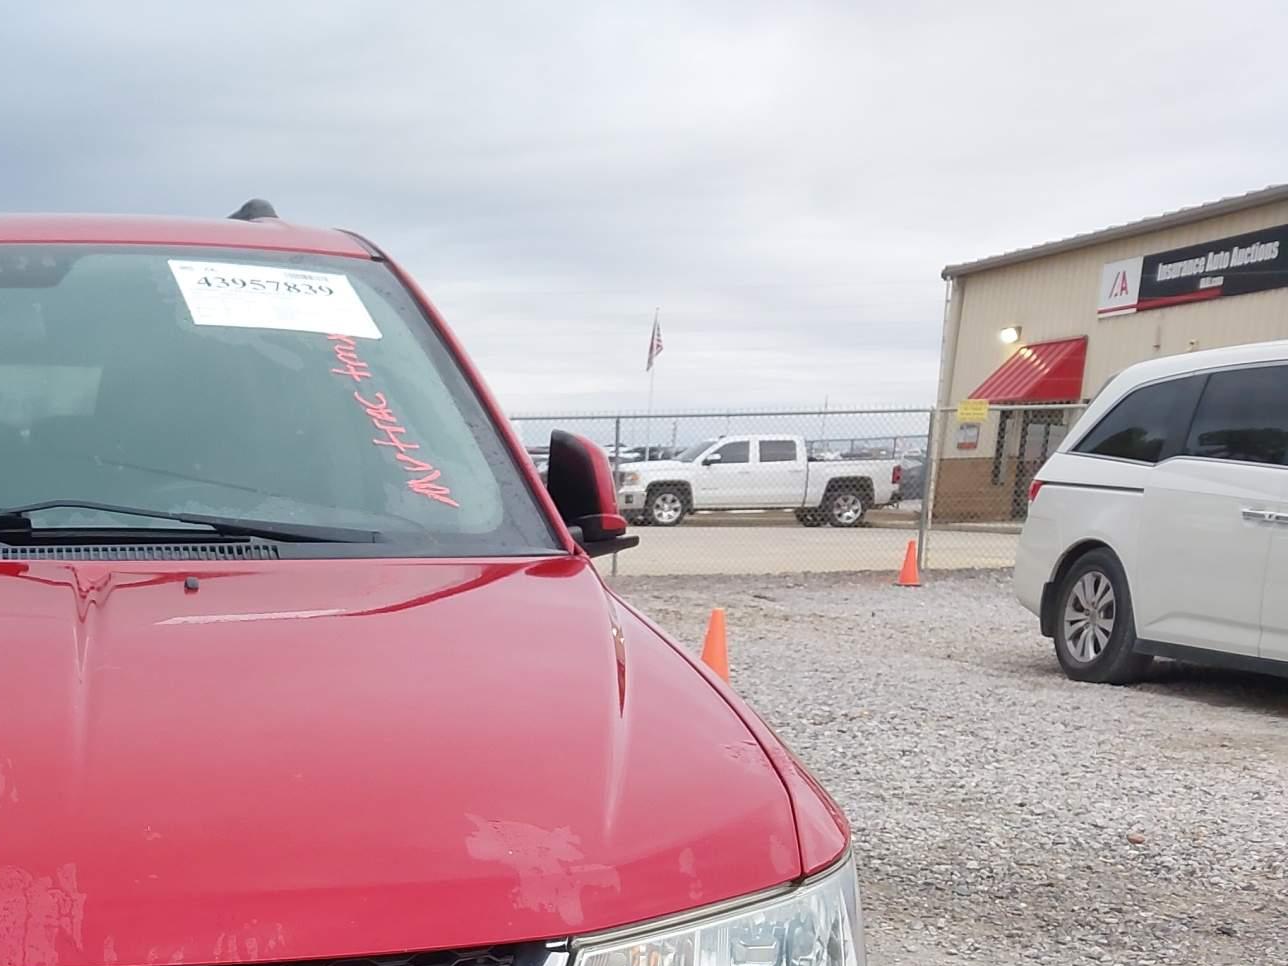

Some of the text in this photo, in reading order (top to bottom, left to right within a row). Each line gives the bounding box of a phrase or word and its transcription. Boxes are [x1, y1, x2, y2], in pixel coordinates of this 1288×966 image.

[1156, 240, 1280, 281] Insurance Auto Auctions
[197, 275, 334, 297] 43957839
